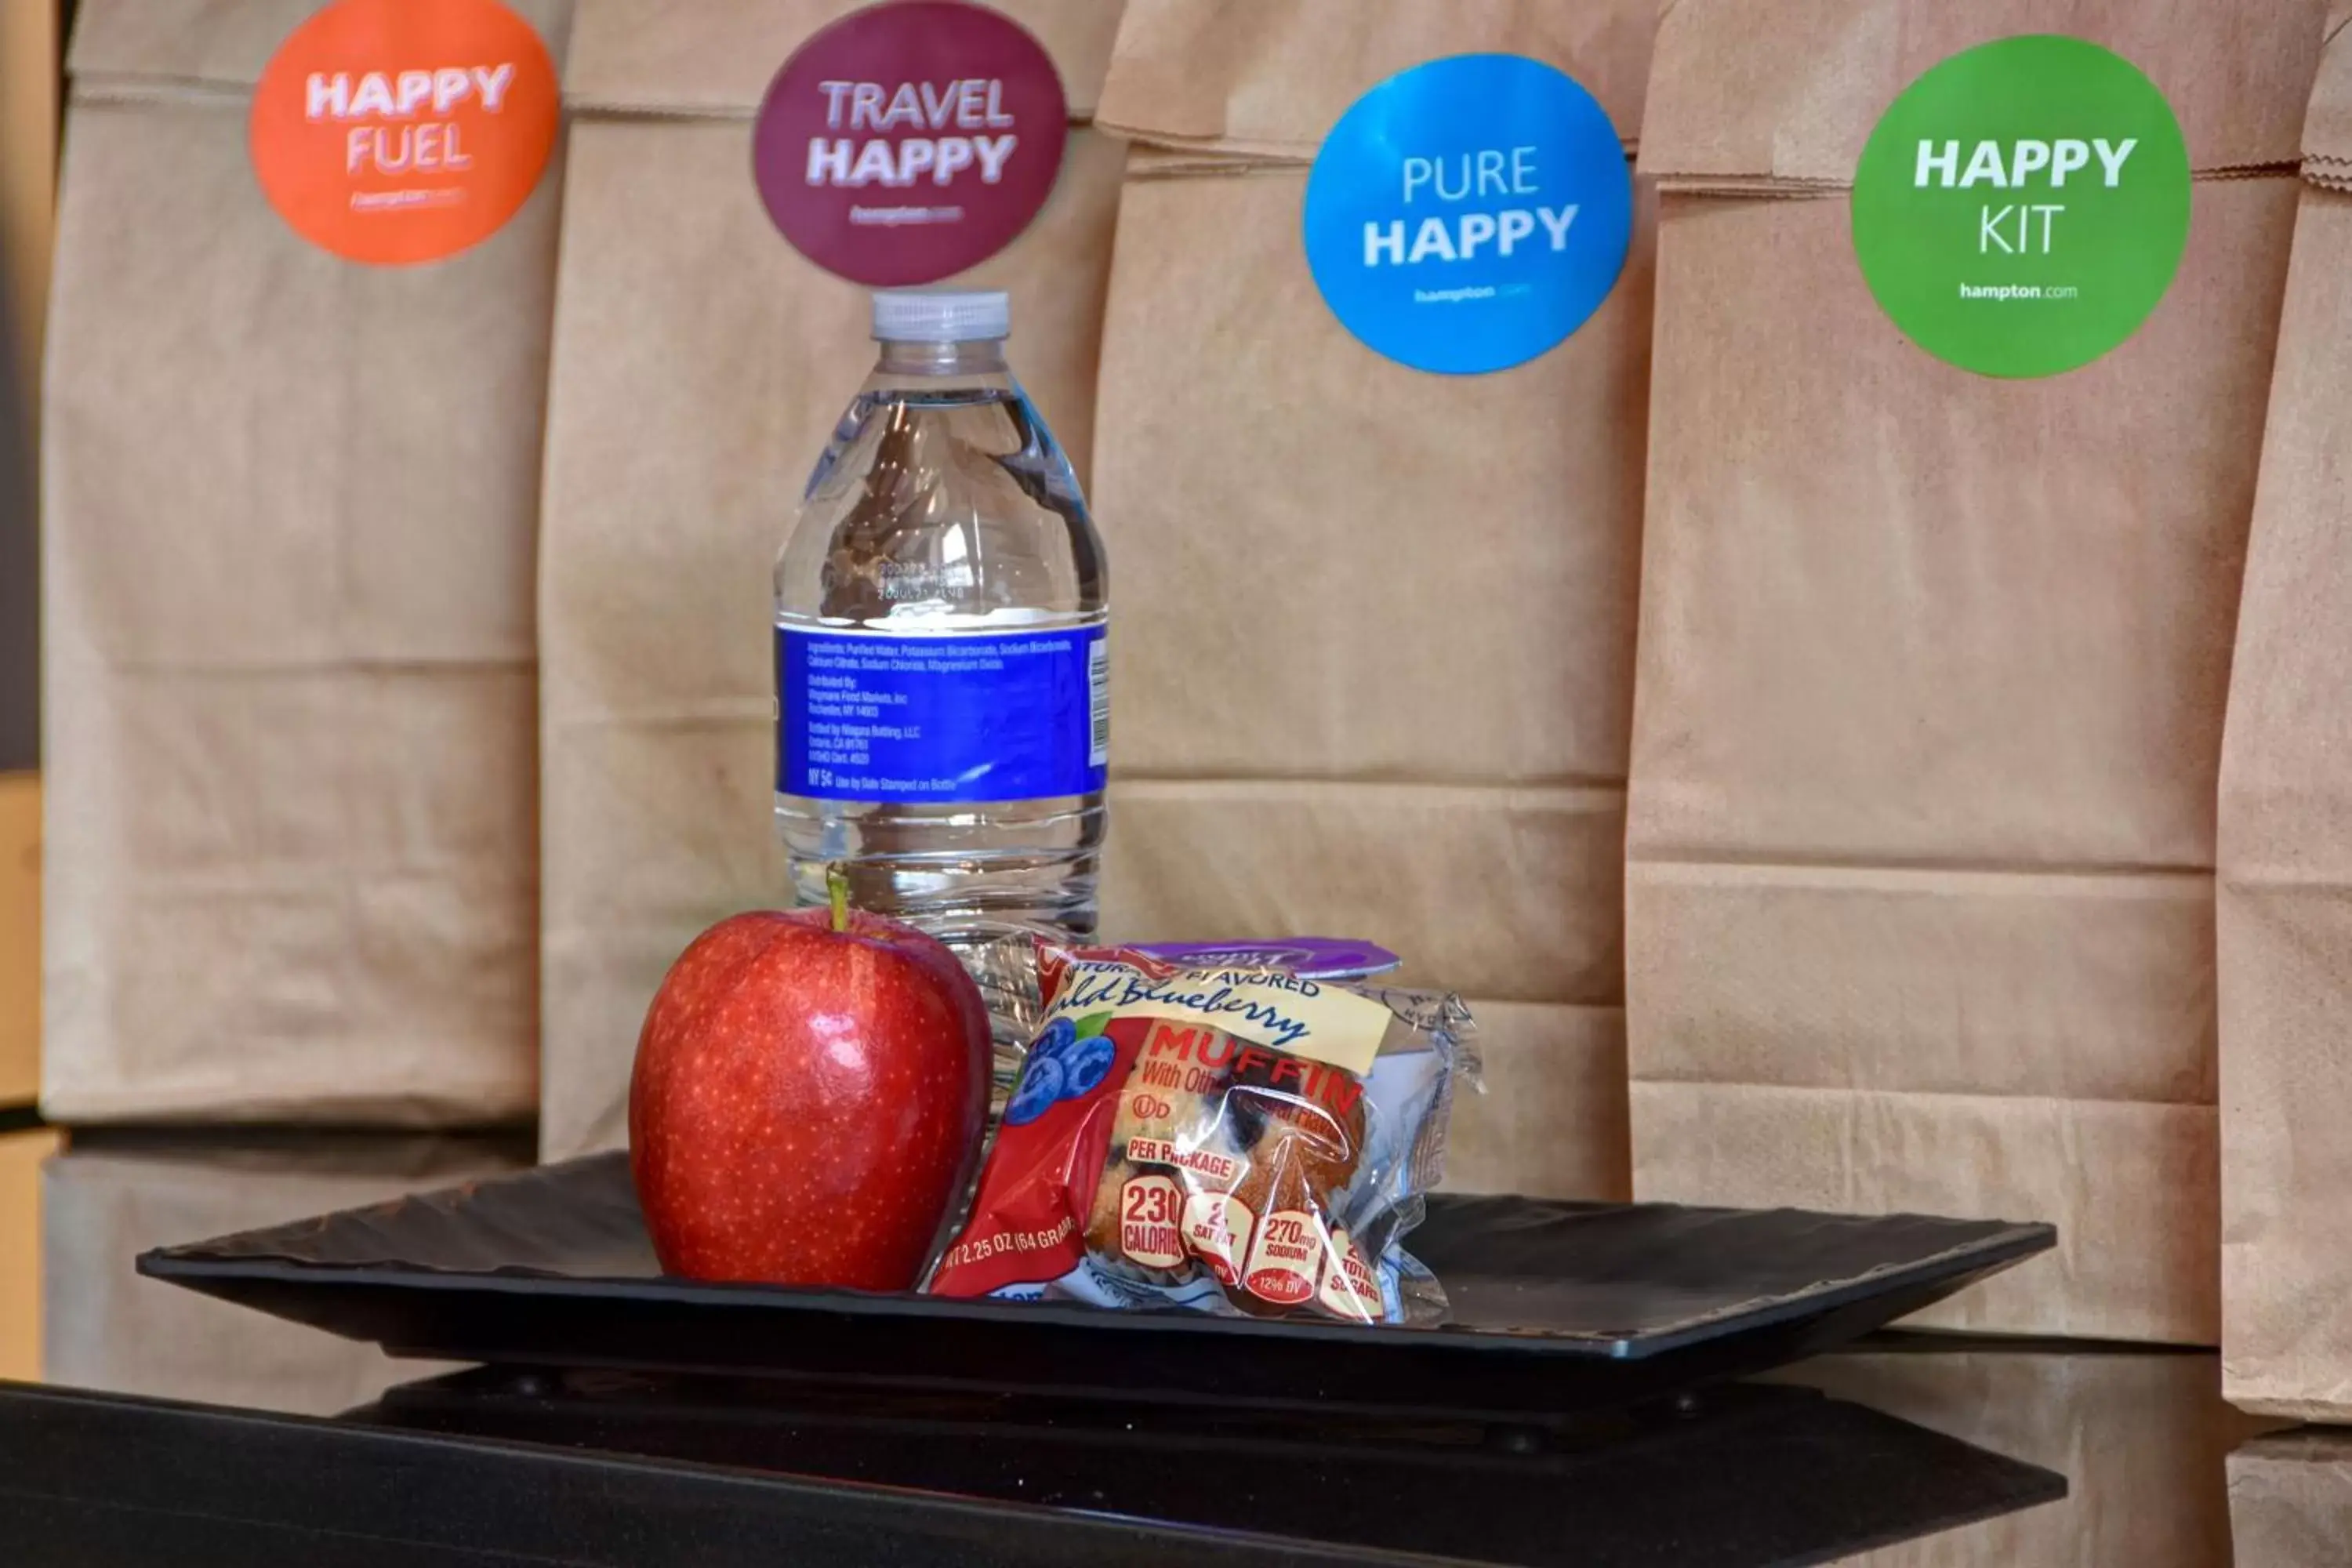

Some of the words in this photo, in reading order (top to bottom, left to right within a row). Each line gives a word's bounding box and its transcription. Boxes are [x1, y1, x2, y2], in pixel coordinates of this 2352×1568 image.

[305, 64, 514, 120] HAPPY
[818, 78, 1014, 132] TRAVEL
[347, 123, 472, 174] FUEL
[805, 134, 1017, 187] HAPPY
[1915, 139, 2139, 187] HAPPY
[1403, 146, 1540, 203] PURE
[1363, 204, 1580, 267] HAPPY
[1980, 205, 2065, 254] KIT
[1960, 282, 2078, 301] hampton.com
[1116, 977, 1310, 1045] Blueberry
[1142, 1060, 1180, 1091] With
[1149, 1025, 1363, 1116] MUFFIN
[1128, 1139, 1157, 1160] PER
[961, 1239, 992, 1265] 2.25
[993, 1232, 1014, 1252] OZ
[1014, 1232, 1036, 1254] (64
[1192, 1224, 1213, 1240] SAT
[1265, 1219, 1316, 1250] 270mg
[1265, 1243, 1308, 1261] SODIUM
[1259, 1277, 1283, 1292] 12%
[1286, 1277, 1302, 1294] DV
